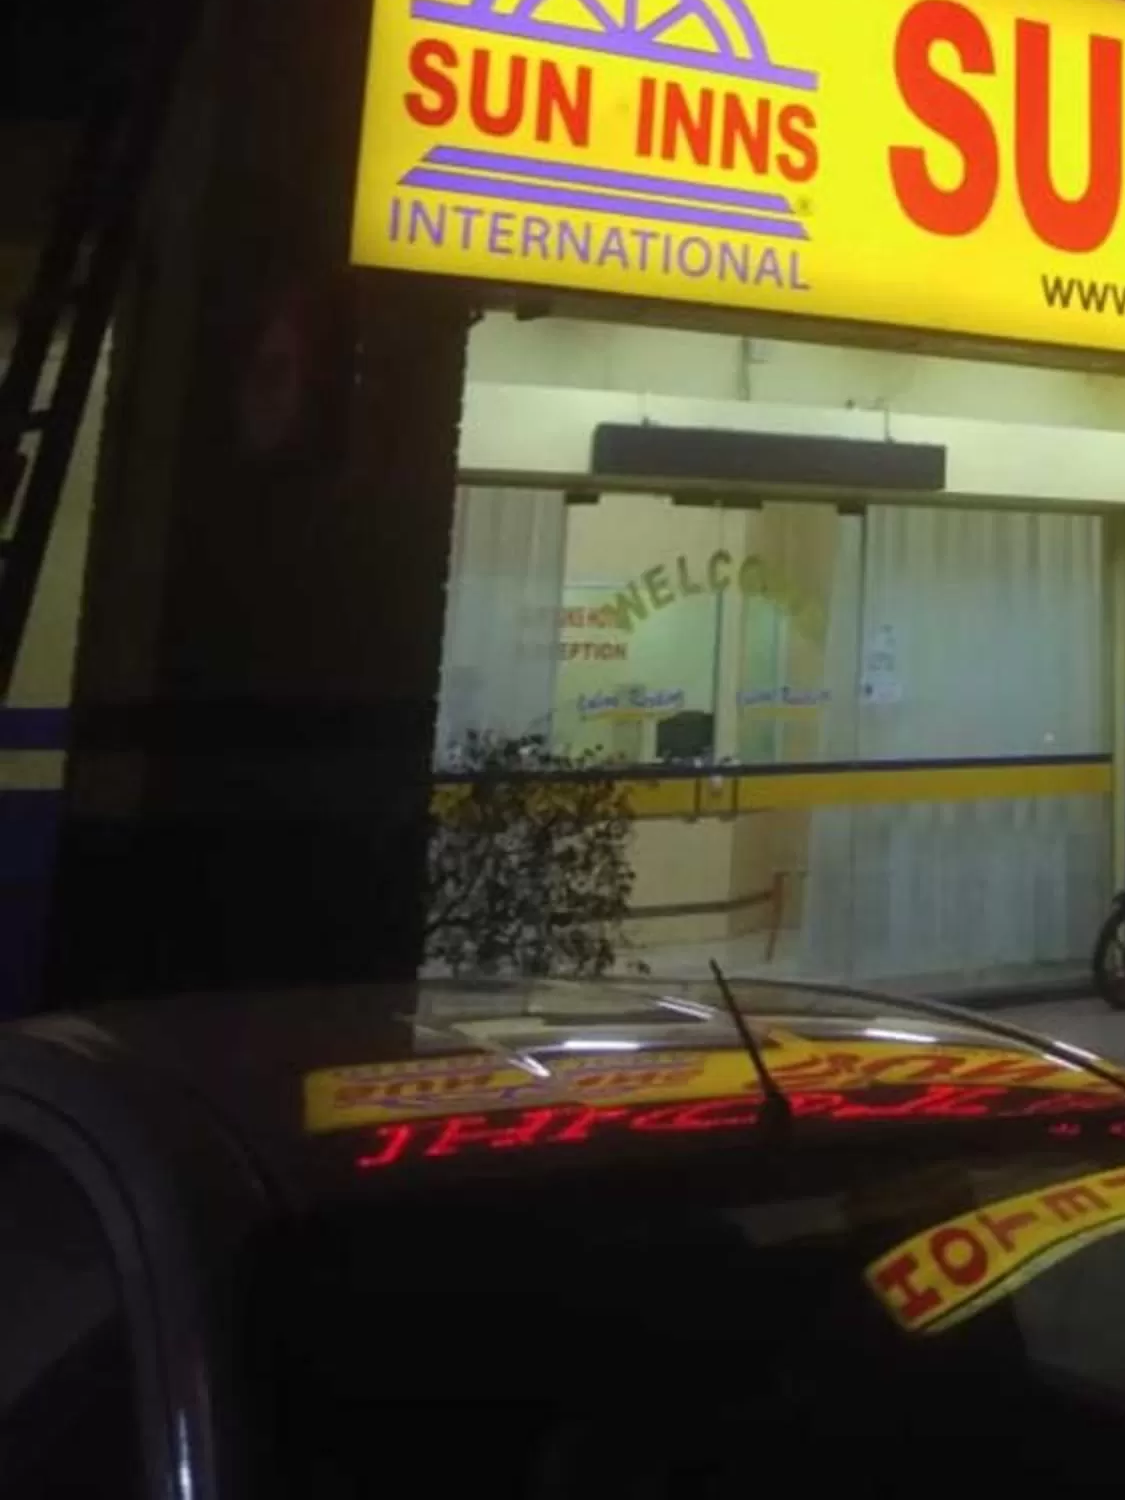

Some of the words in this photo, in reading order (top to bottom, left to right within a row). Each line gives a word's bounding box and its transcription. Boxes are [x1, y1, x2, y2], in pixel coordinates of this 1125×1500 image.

[403, 38, 591, 148] SUN
[637, 76, 820, 184] INNS
[387, 196, 811, 292] INTERNATIONAL
